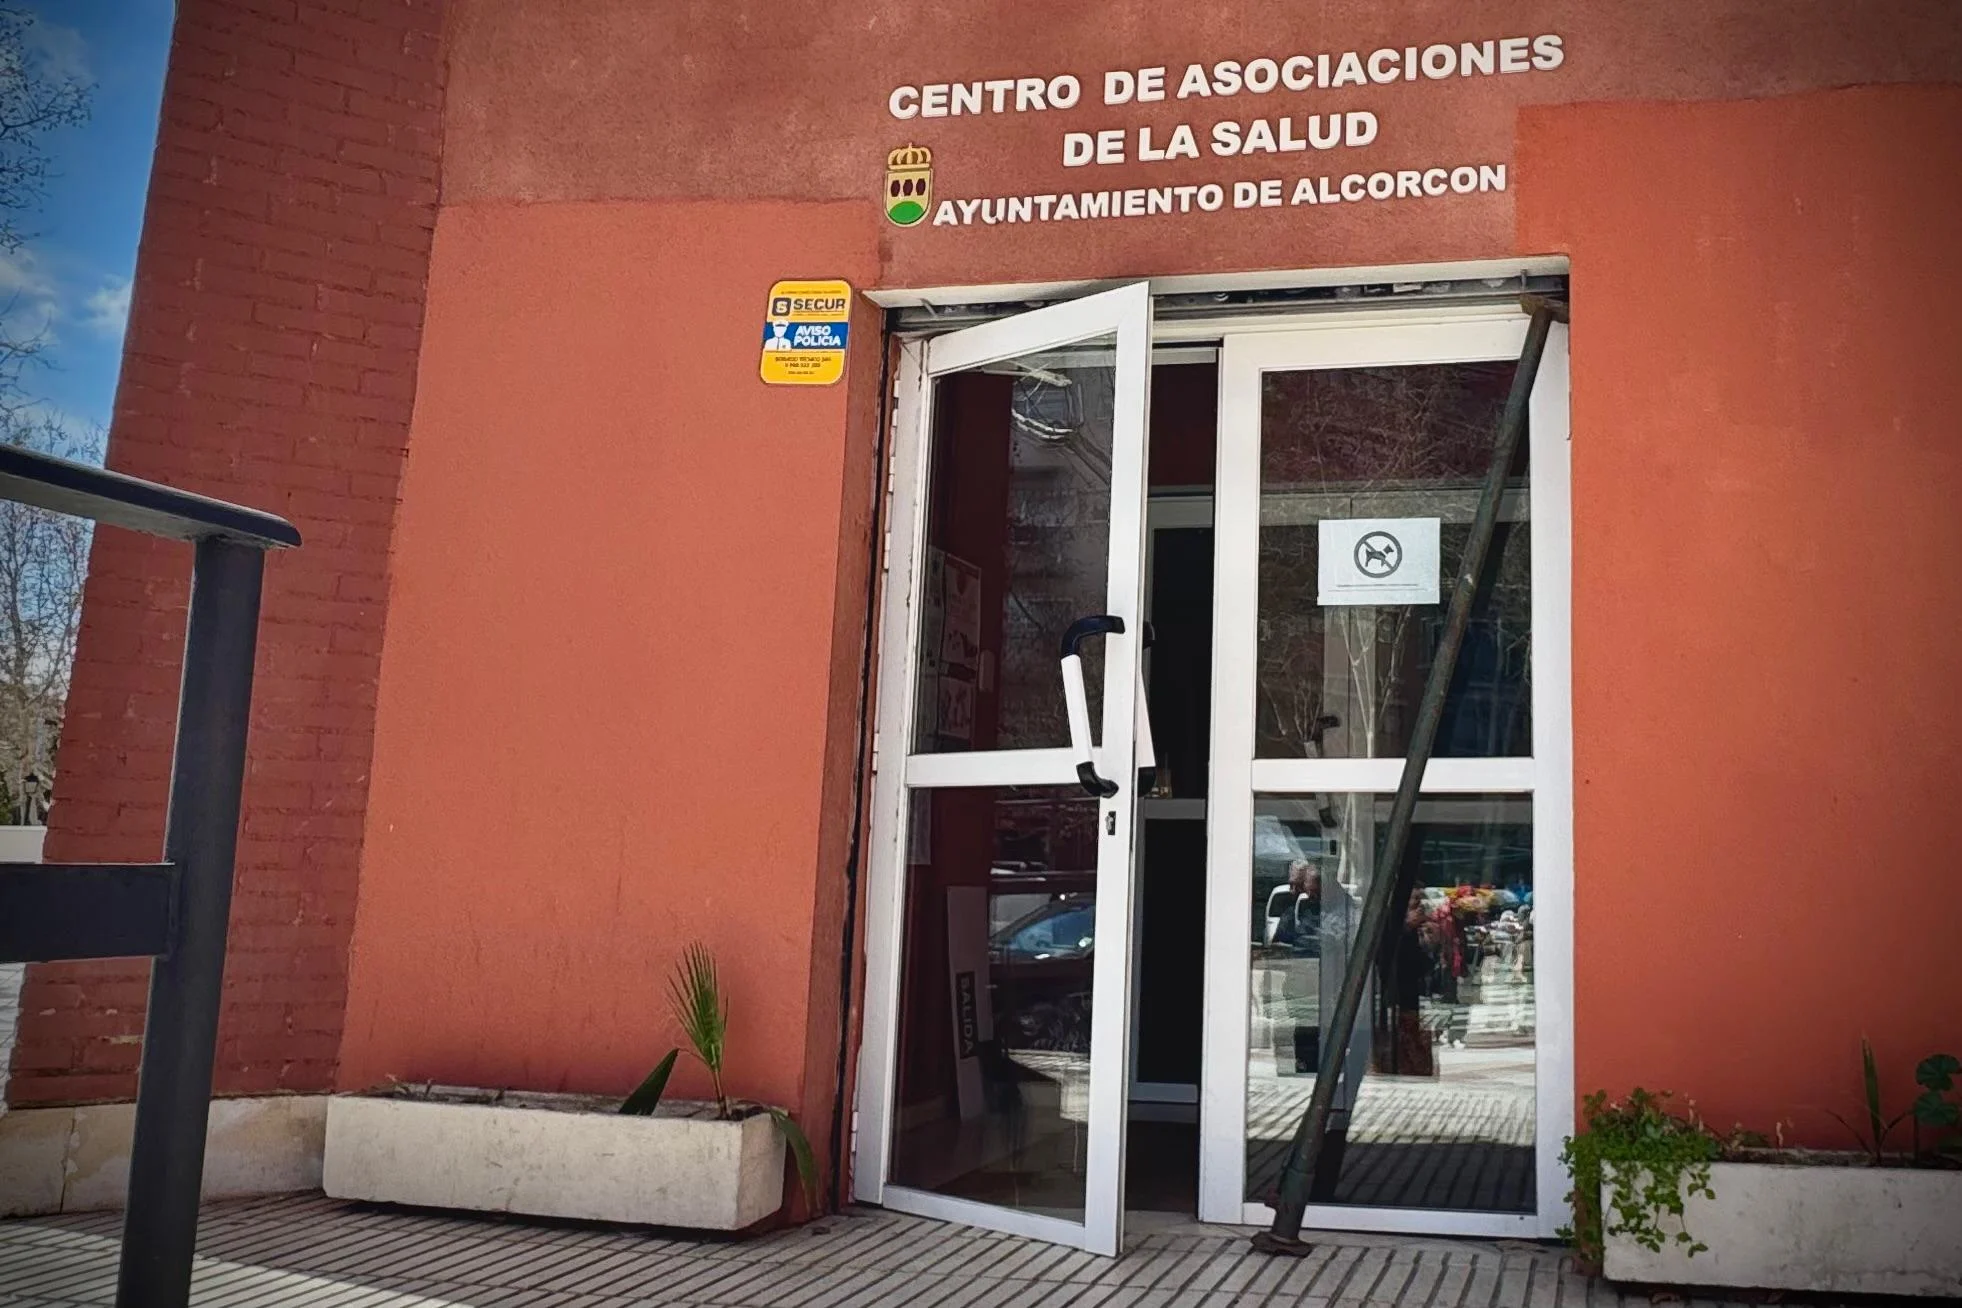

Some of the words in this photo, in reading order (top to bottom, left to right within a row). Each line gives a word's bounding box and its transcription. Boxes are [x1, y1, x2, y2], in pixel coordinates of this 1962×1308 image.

[888, 74, 1081, 119] CENTRO
[1103, 66, 1166, 105] DE
[1177, 34, 1564, 98] ASOCIACIONES
[1063, 129, 1126, 167] DE
[1138, 124, 1200, 161] LA
[1210, 111, 1378, 157] SALUD
[932, 182, 1224, 227] AYUNTAMIENTO
[1233, 179, 1283, 209] DE
[1290, 164, 1506, 206] ALCORCON
[793, 298, 846, 310] SECUR
[795, 325, 831, 336] AVISO
[793, 335, 842, 347] POLICIA
[960, 976, 975, 1055] SALIDA
